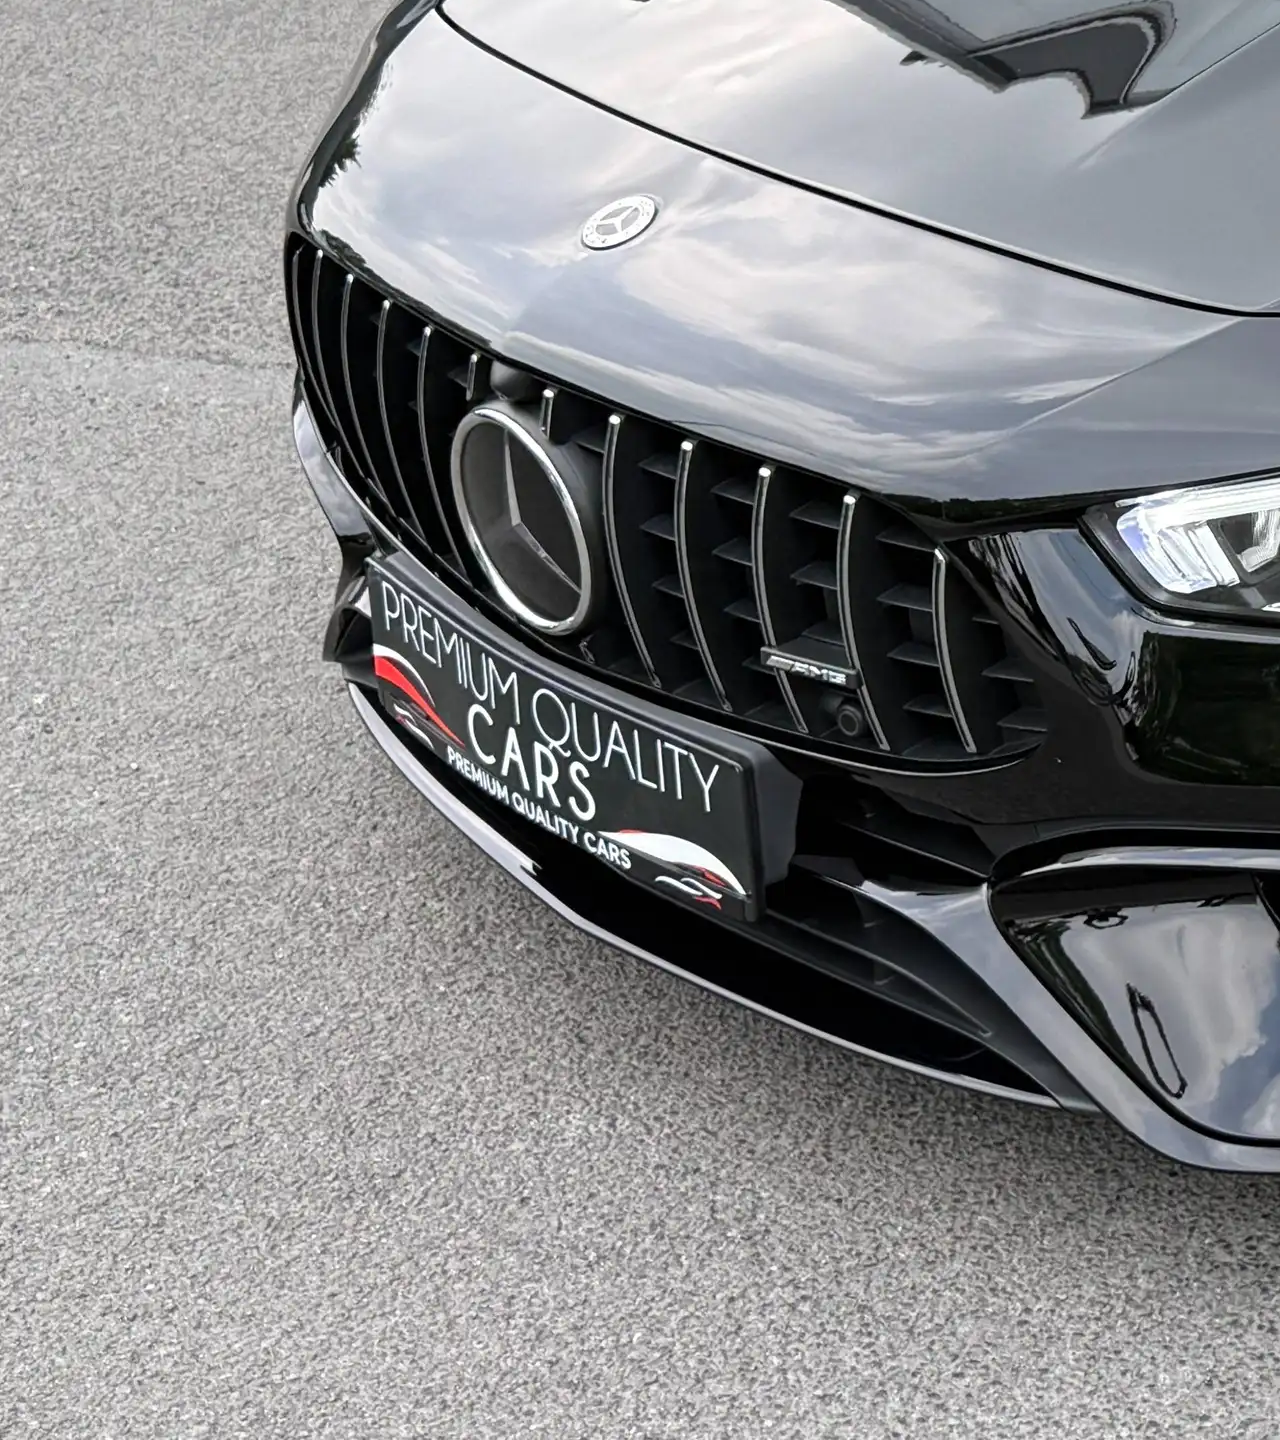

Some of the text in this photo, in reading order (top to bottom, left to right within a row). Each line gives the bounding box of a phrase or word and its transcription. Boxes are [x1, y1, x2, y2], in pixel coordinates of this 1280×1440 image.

[382, 580, 720, 813] PREMIUM QUALITY
[790, 661, 847, 685] AMG
[446, 745, 632, 870] PREMIUM QUALITY CARS
[467, 703, 597, 822] CARS
